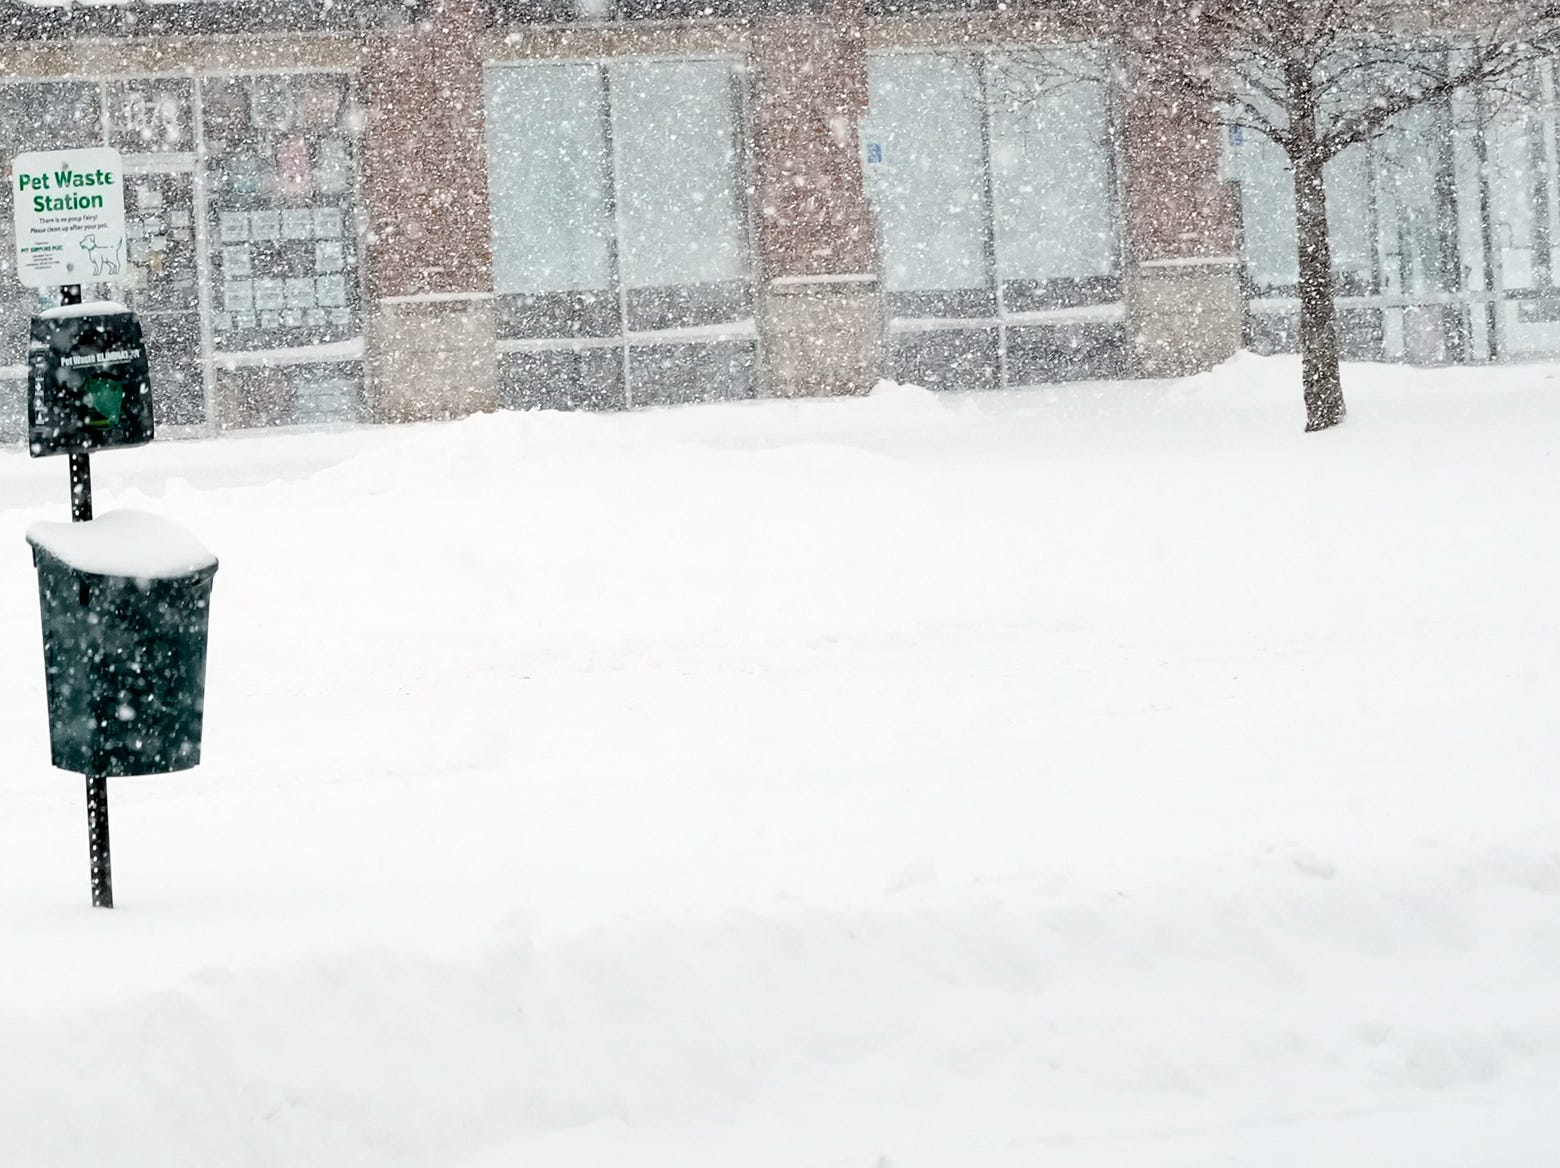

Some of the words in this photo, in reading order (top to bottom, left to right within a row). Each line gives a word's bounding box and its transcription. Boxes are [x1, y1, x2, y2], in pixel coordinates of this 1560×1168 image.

[19, 173, 50, 191] Pet
[54, 169, 115, 188] Waste
[33, 192, 104, 212] Station
[60, 356, 73, 366] Pet
